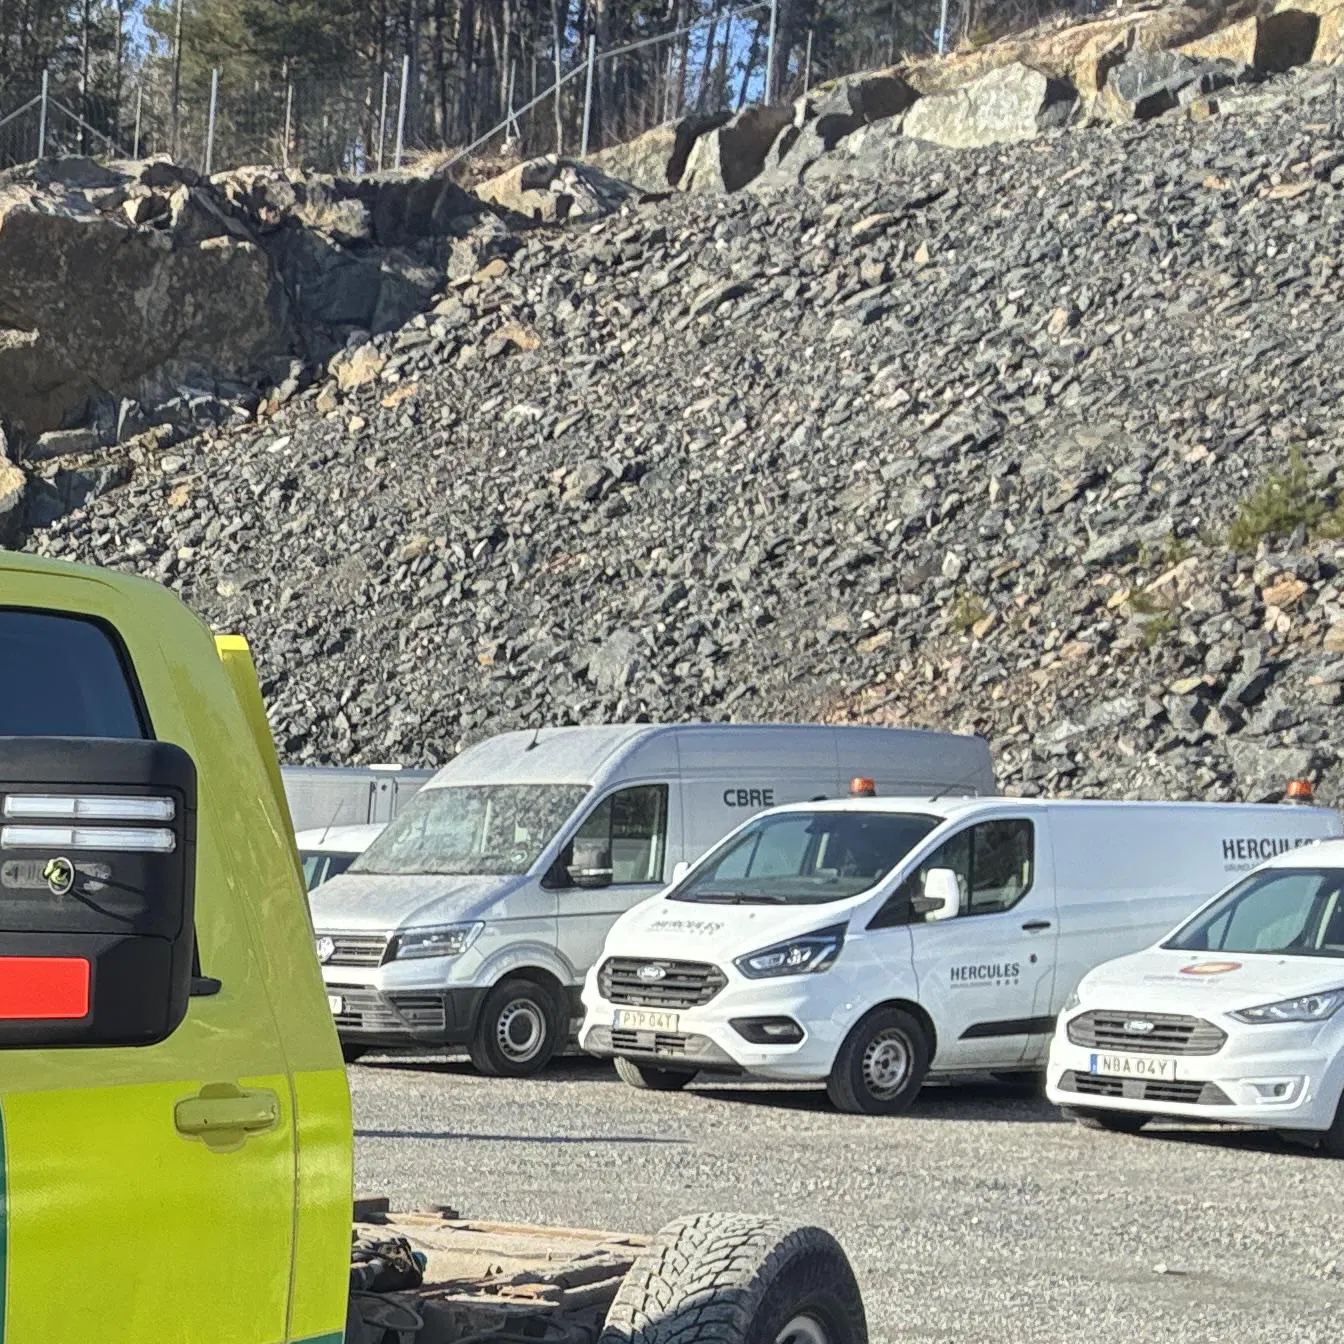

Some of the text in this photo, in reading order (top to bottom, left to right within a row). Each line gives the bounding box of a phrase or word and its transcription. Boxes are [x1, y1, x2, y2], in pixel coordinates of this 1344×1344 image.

[723, 788, 775, 807] CBRE
[950, 962, 1020, 981] HERCULES
[1136, 1060, 1169, 1075] 04Y
